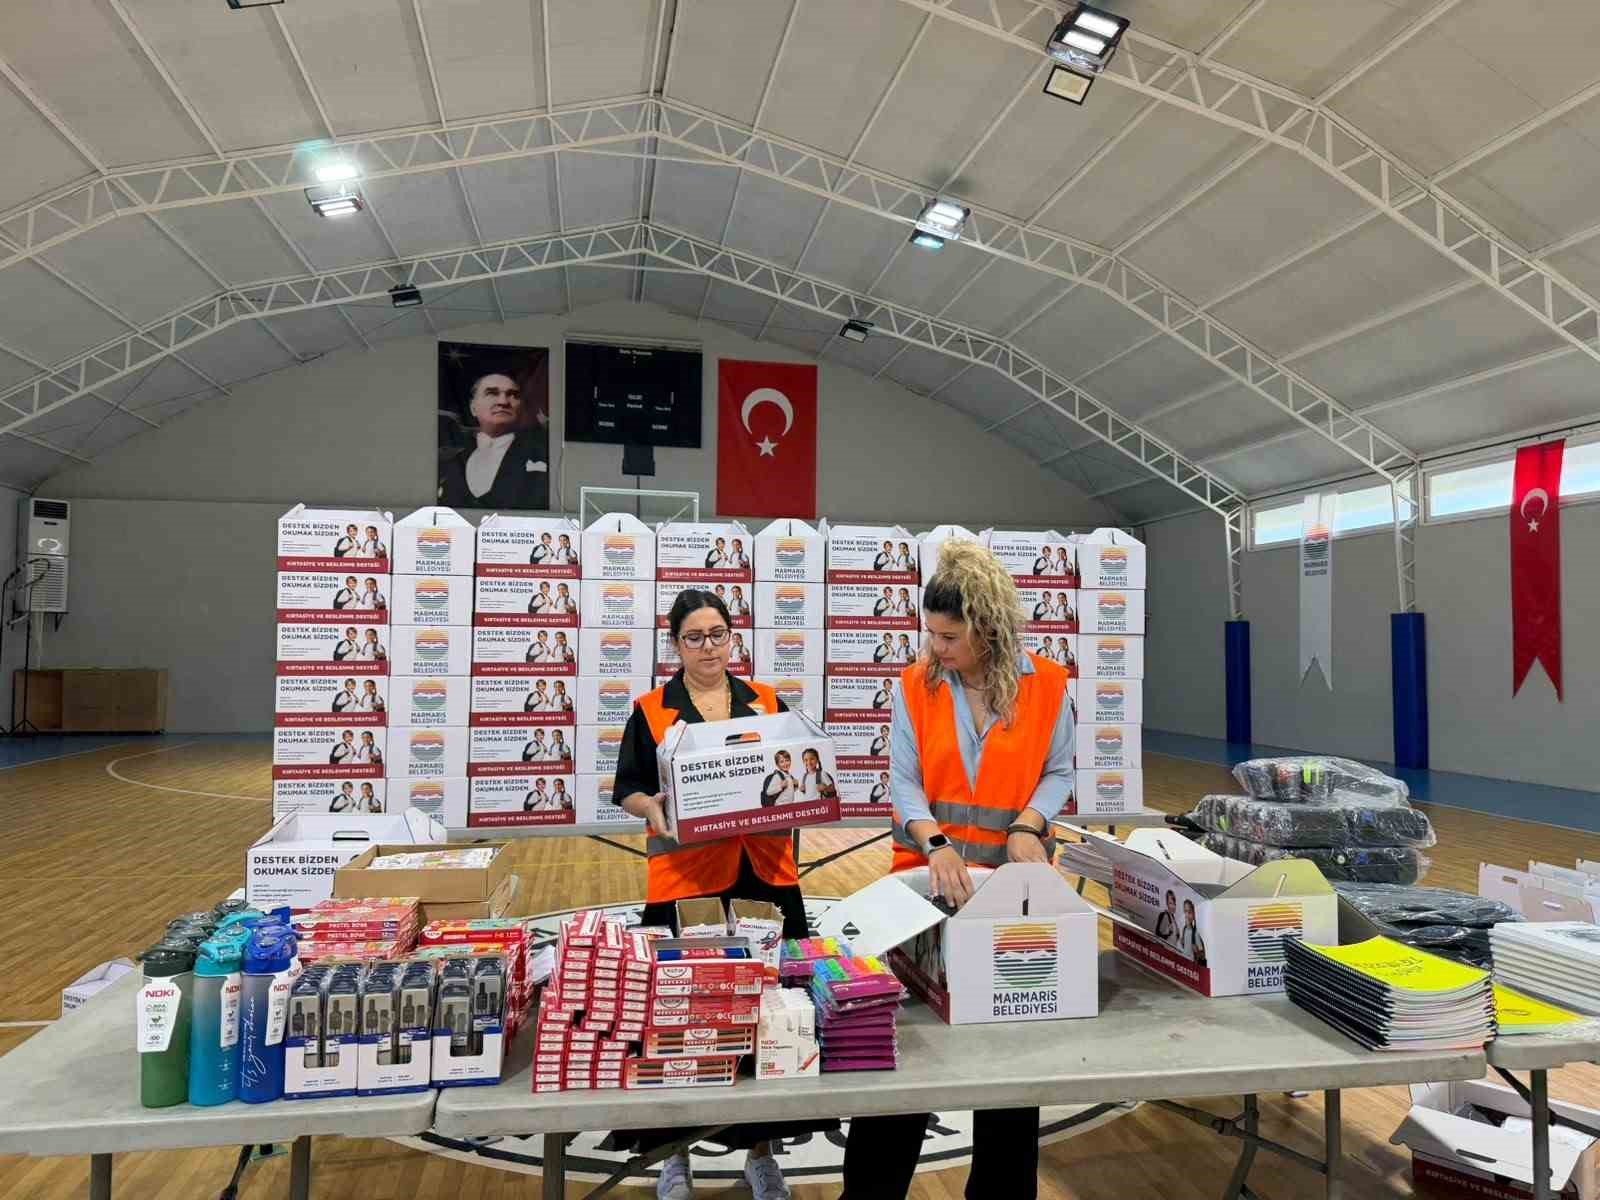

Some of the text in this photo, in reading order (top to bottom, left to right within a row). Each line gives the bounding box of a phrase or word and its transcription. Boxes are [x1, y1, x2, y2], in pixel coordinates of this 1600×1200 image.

[680, 754, 764, 772] DESTEK BİZDEN
[681, 765, 765, 784] OKUMAK SİZDEN
[694, 821, 736, 833] KIRTASİYE
[752, 813, 793, 824] BESLENME
[796, 806, 829, 818] DESTEĞİ
[299, 855, 338, 864] BİZDEN
[254, 868, 298, 876] OKUMAK
[1248, 965, 1287, 977] MARMA
[993, 1002, 1057, 1016] BELEDİYESİ
